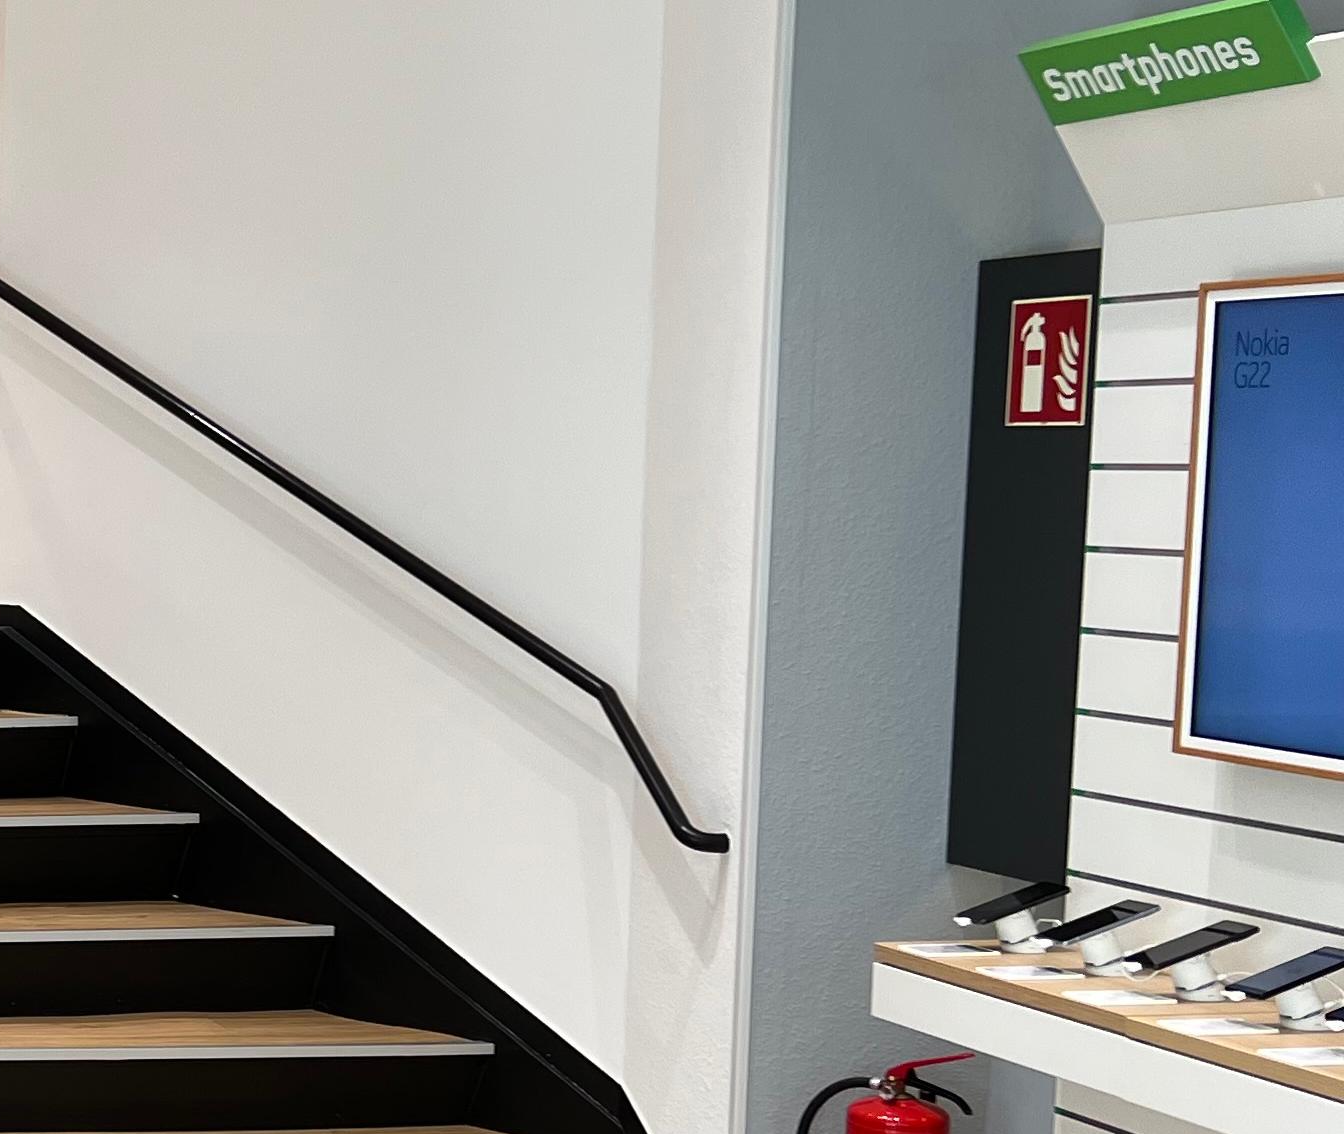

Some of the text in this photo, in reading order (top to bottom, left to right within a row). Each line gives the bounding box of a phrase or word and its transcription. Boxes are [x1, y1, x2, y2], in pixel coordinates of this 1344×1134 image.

[1042, 36, 1261, 102] Smartphones
[1235, 330, 1290, 357] Nokia
[1234, 361, 1271, 389] G22
